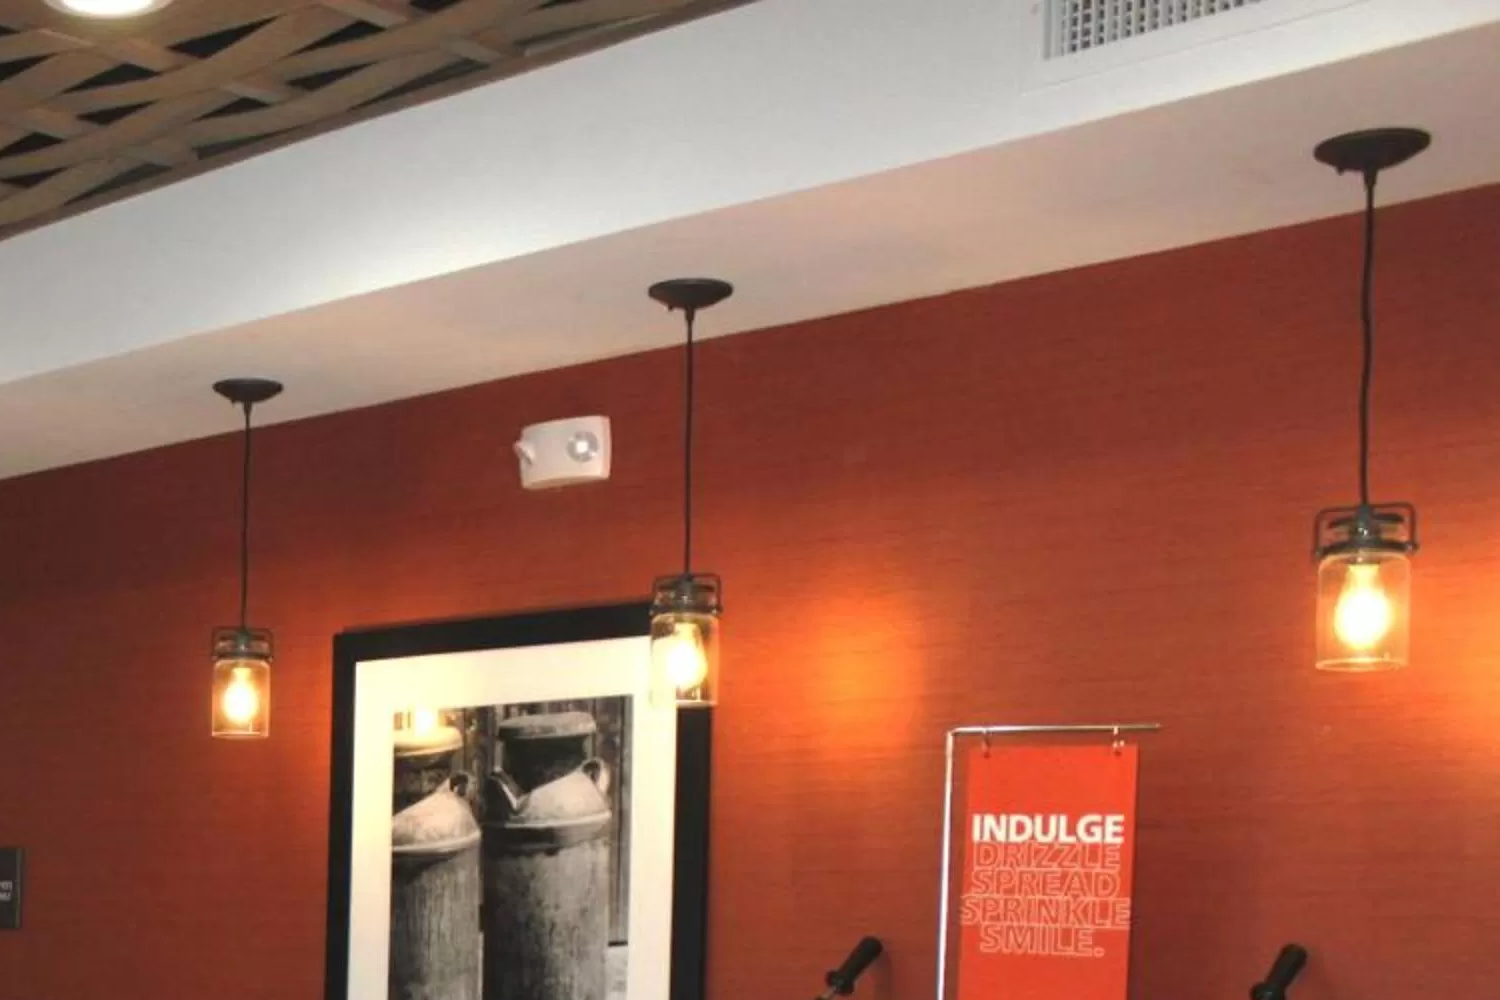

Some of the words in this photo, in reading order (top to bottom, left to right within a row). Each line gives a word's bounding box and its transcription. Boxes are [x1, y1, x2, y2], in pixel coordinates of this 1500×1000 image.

[971, 814, 1125, 843] INDULGE
[973, 842, 1122, 871] DRIZZLE
[971, 868, 1121, 898] SPREAD
[960, 895, 1132, 928] SPRINKLE
[979, 923, 1105, 957] SMILE.
